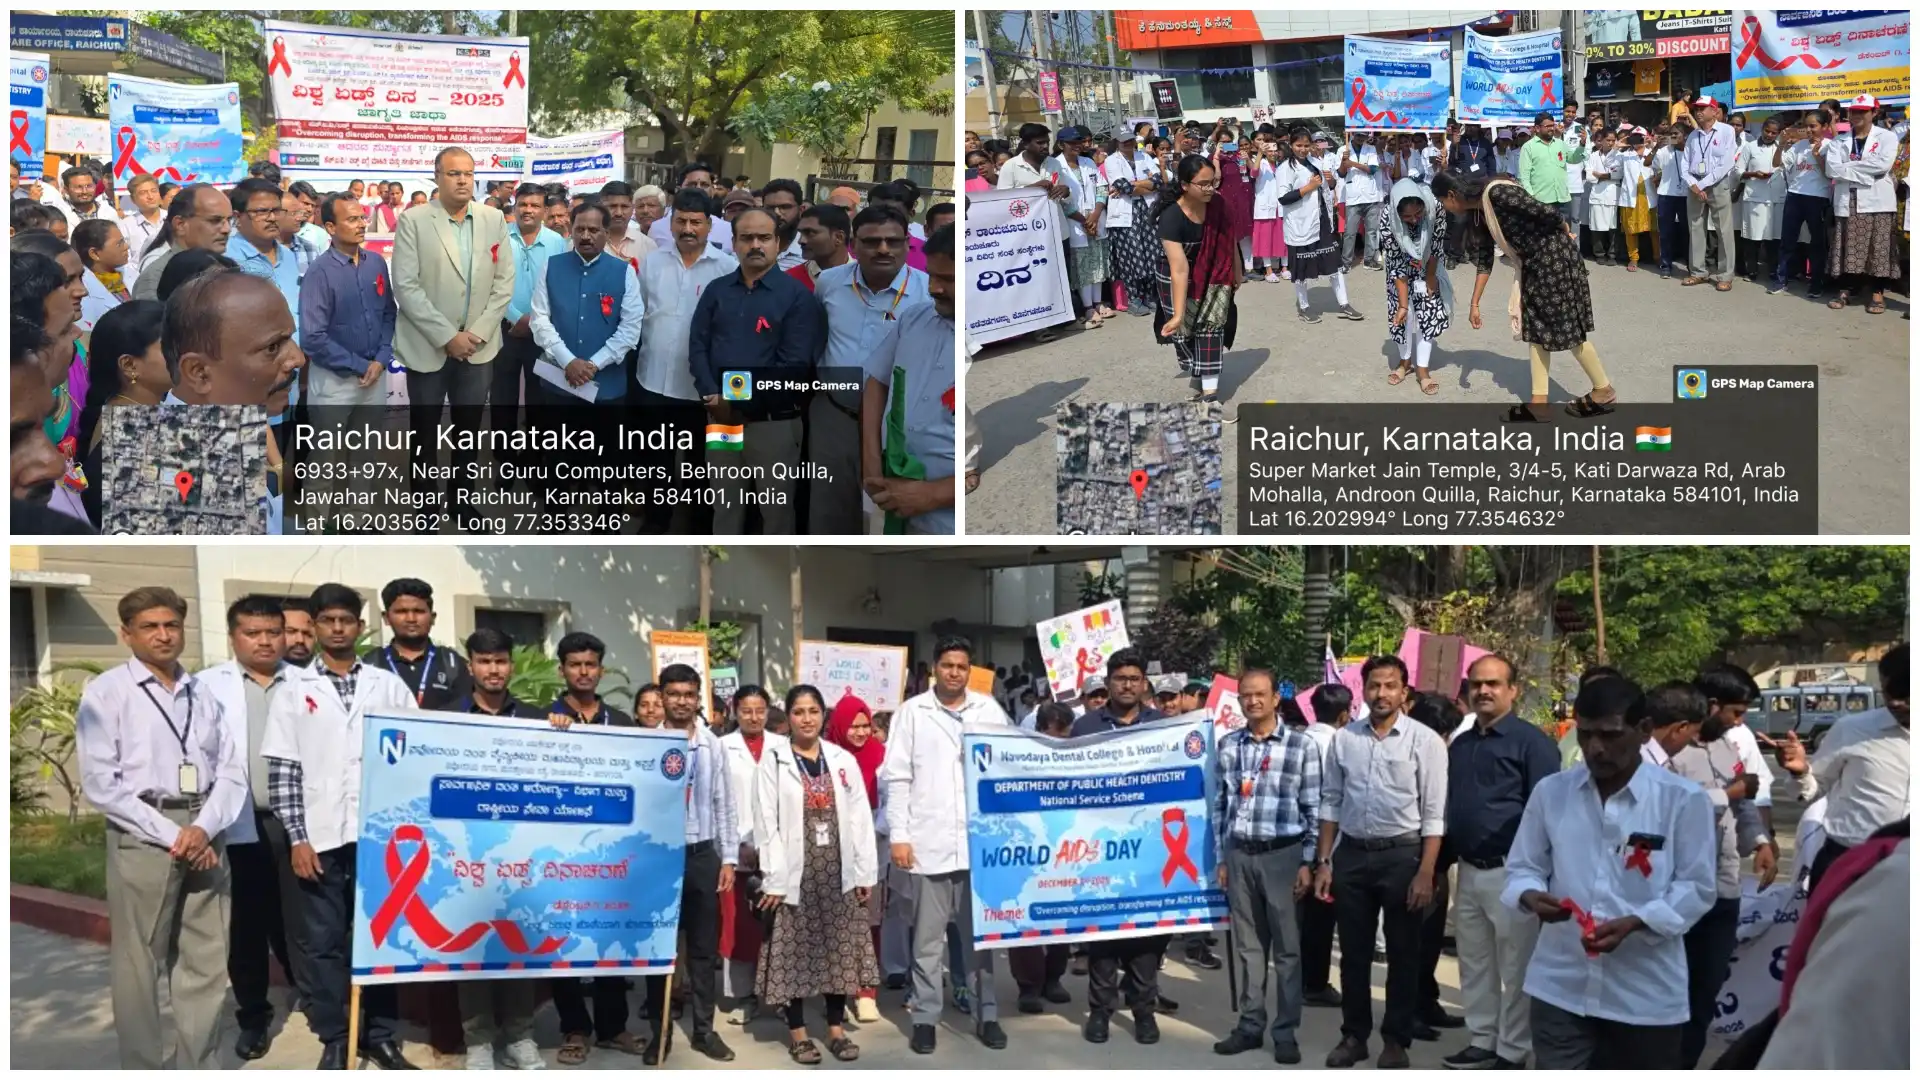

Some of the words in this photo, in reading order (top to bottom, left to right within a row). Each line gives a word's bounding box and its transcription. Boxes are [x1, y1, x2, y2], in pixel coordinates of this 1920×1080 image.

[1661, 20, 1680, 28] Jeans
[1685, 18, 1713, 26] T-Shirts
[1714, 25, 1728, 33] Kati
[35, 39, 73, 49] OFFICE,
[1607, 45, 1625, 57] TO
[1629, 43, 1655, 56] 30%
[1657, 38, 1729, 55] DISCOUNT
[456, 48, 490, 58] KSAPS
[1466, 81, 1493, 92] WORLD
[1516, 86, 1532, 95] DAY
[1821, 88, 1867, 98] transforming
[1884, 84, 1903, 92] AIDS
[292, 86, 324, 106] ವಿಶ್ವ
[335, 86, 375, 106] ಏಡ್ಸ್
[386, 90, 417, 104] ದಿನ
[450, 92, 504, 106] 2025
[388, 133, 435, 142] transforming
[976, 222, 1028, 238] ರಾಯಚೂರು
[1032, 219, 1047, 231] (ರಿ)
[1001, 751, 1050, 765] Navodaya
[1053, 750, 1084, 762] Dental
[1088, 748, 1124, 761] College
[1126, 746, 1134, 756] &
[495, 781, 519, 792] ದಂತ
[994, 780, 1056, 794] DEPARTMENT
[1057, 780, 1068, 790] OF
[1072, 778, 1104, 790] PUBLIC
[1106, 774, 1138, 788] HEALTH
[1141, 770, 1186, 785] DENTISTRY
[1040, 794, 1077, 807] National
[1079, 793, 1110, 805] Service
[1112, 791, 1145, 803] Scheme
[981, 844, 1050, 868] WORLD
[1054, 838, 1101, 869] AIDS
[1106, 838, 1142, 861] DAY
[496, 857, 534, 888] ಏಡ್ಸ್
[1037, 878, 1078, 889] DECEMBER
[983, 906, 1025, 922] Theme:
[1118, 898, 1163, 911] transforming
[1165, 897, 1175, 905] the
[1177, 896, 1192, 905] AIDS
